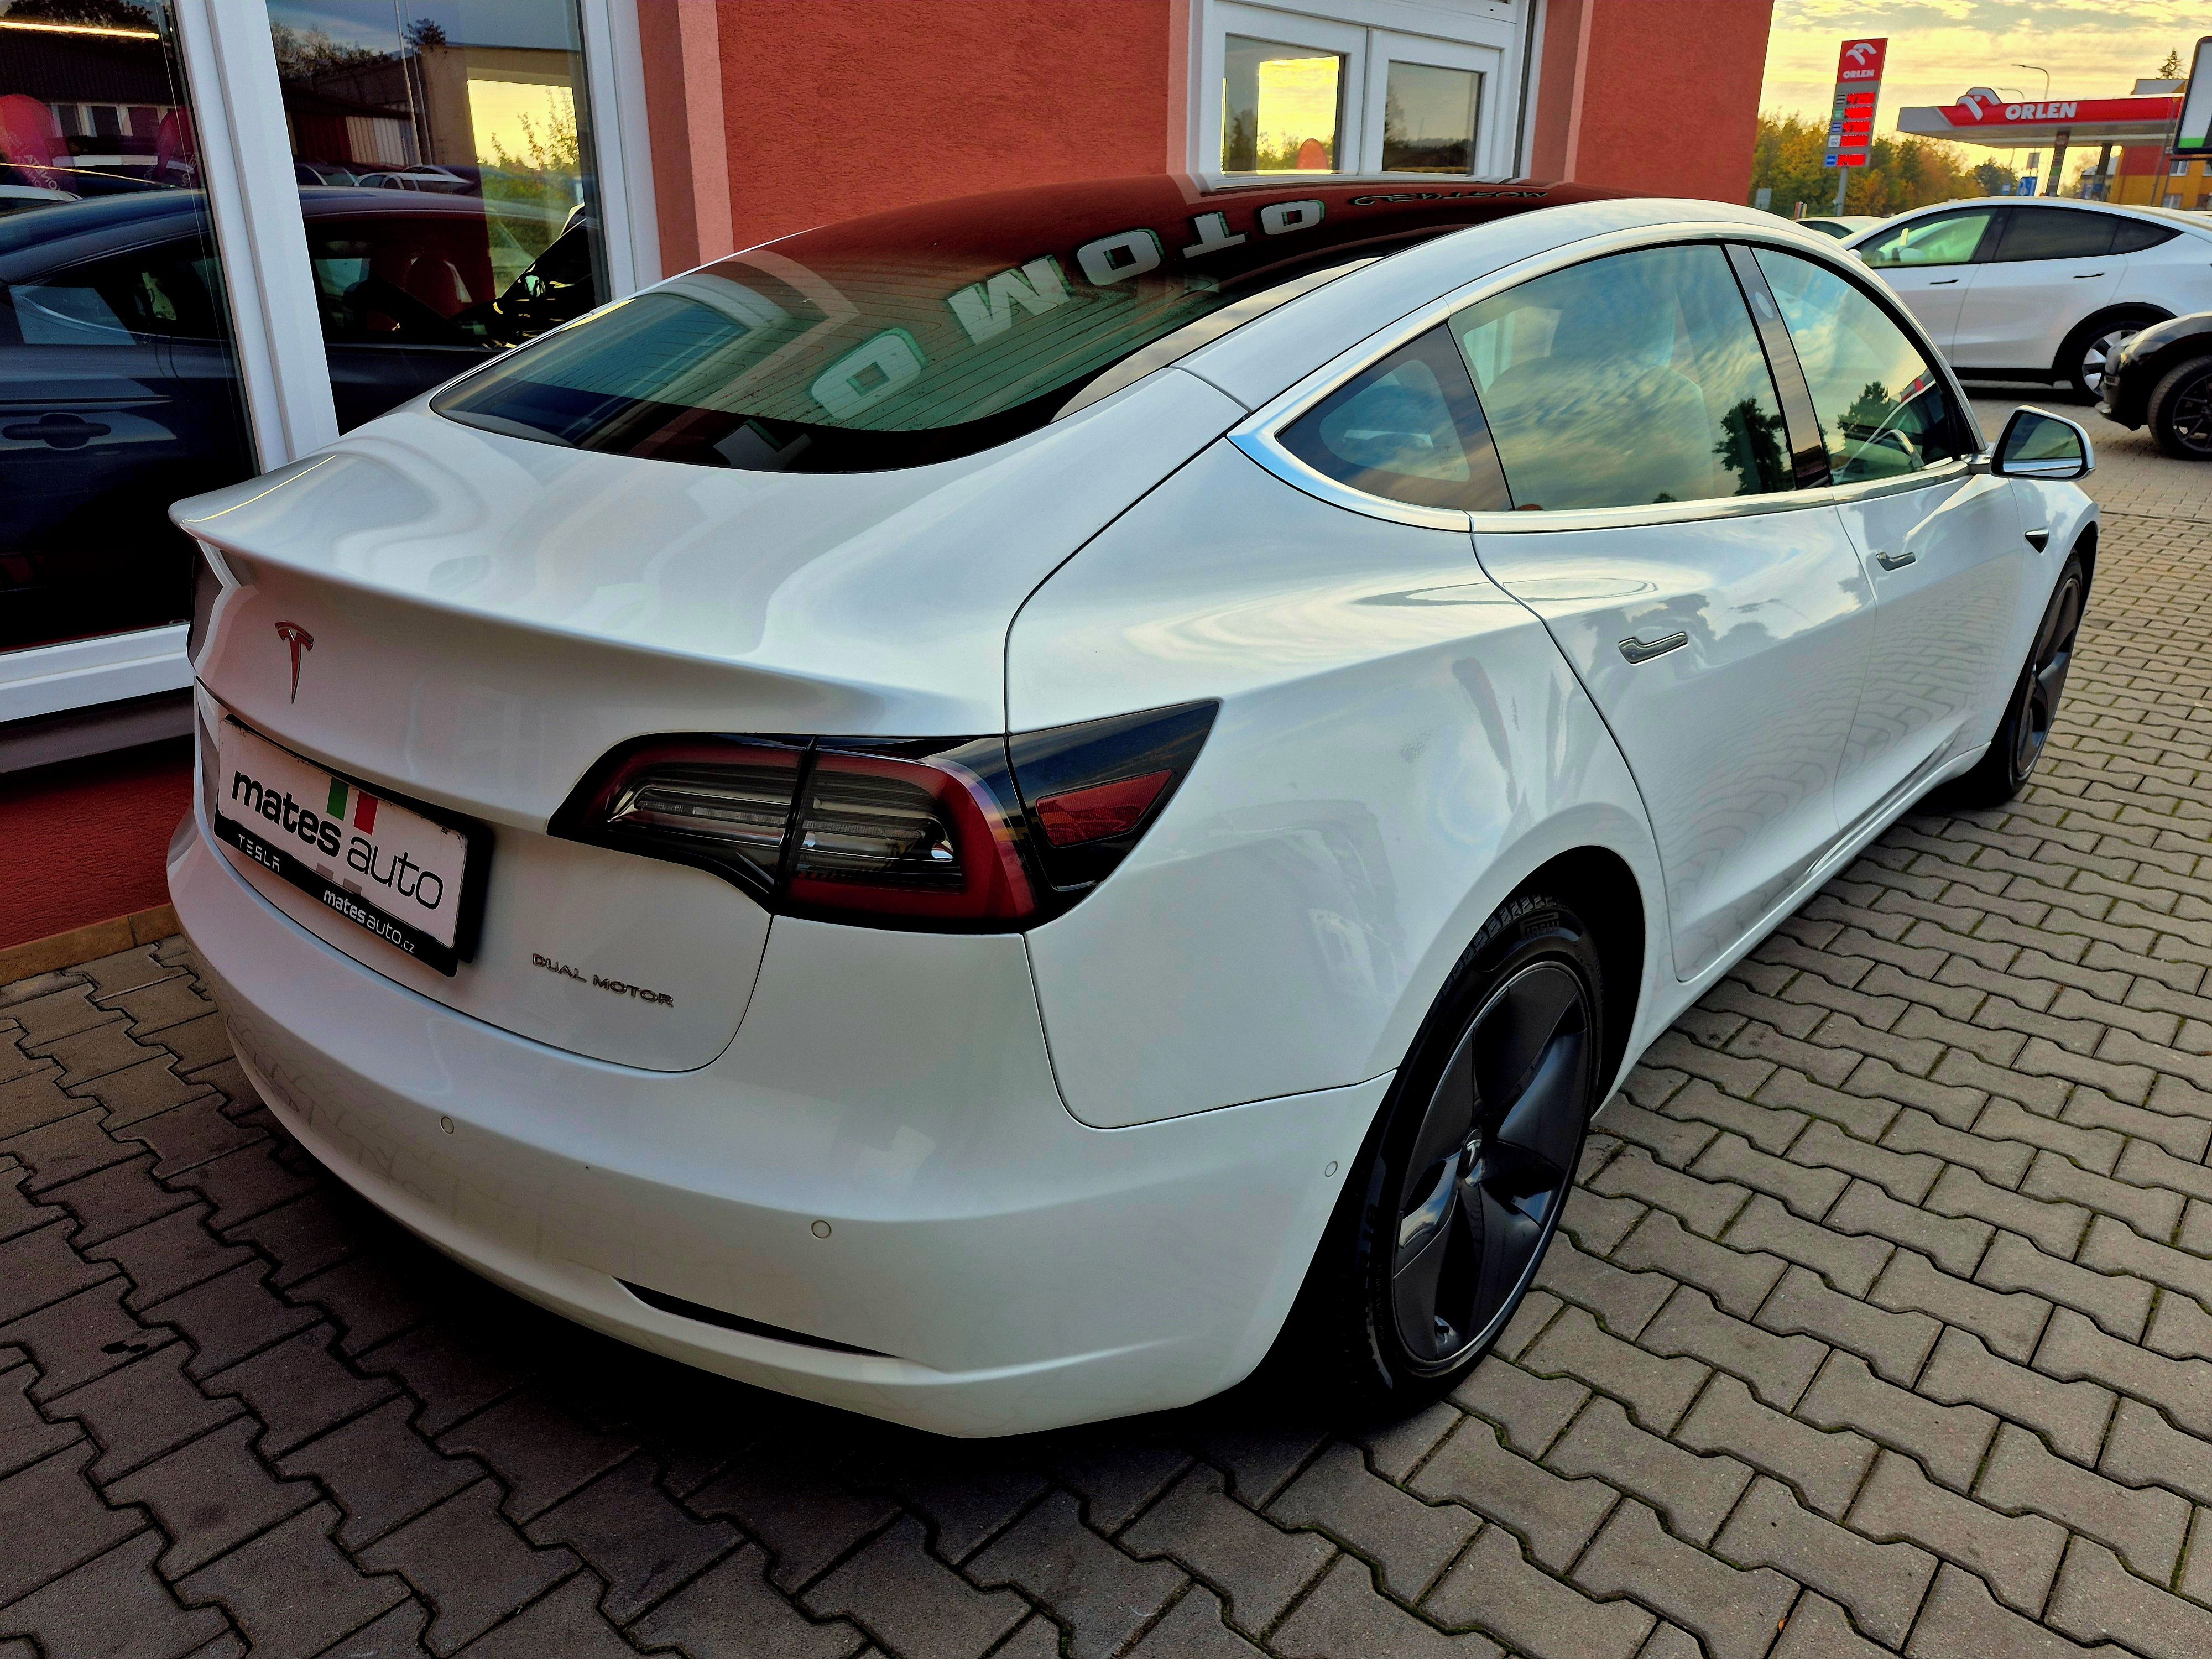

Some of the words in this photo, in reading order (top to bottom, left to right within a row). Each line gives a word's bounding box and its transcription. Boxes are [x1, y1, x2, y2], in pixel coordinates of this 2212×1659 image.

[1843, 69, 1875, 79] ORLEN
[2005, 102, 2078, 121] ORLEN
[231, 770, 342, 858] mates
[346, 836, 444, 910] auto
[238, 834, 280, 873] TESLA
[533, 953, 587, 983] DUAL
[593, 974, 674, 1008] MOTOR
